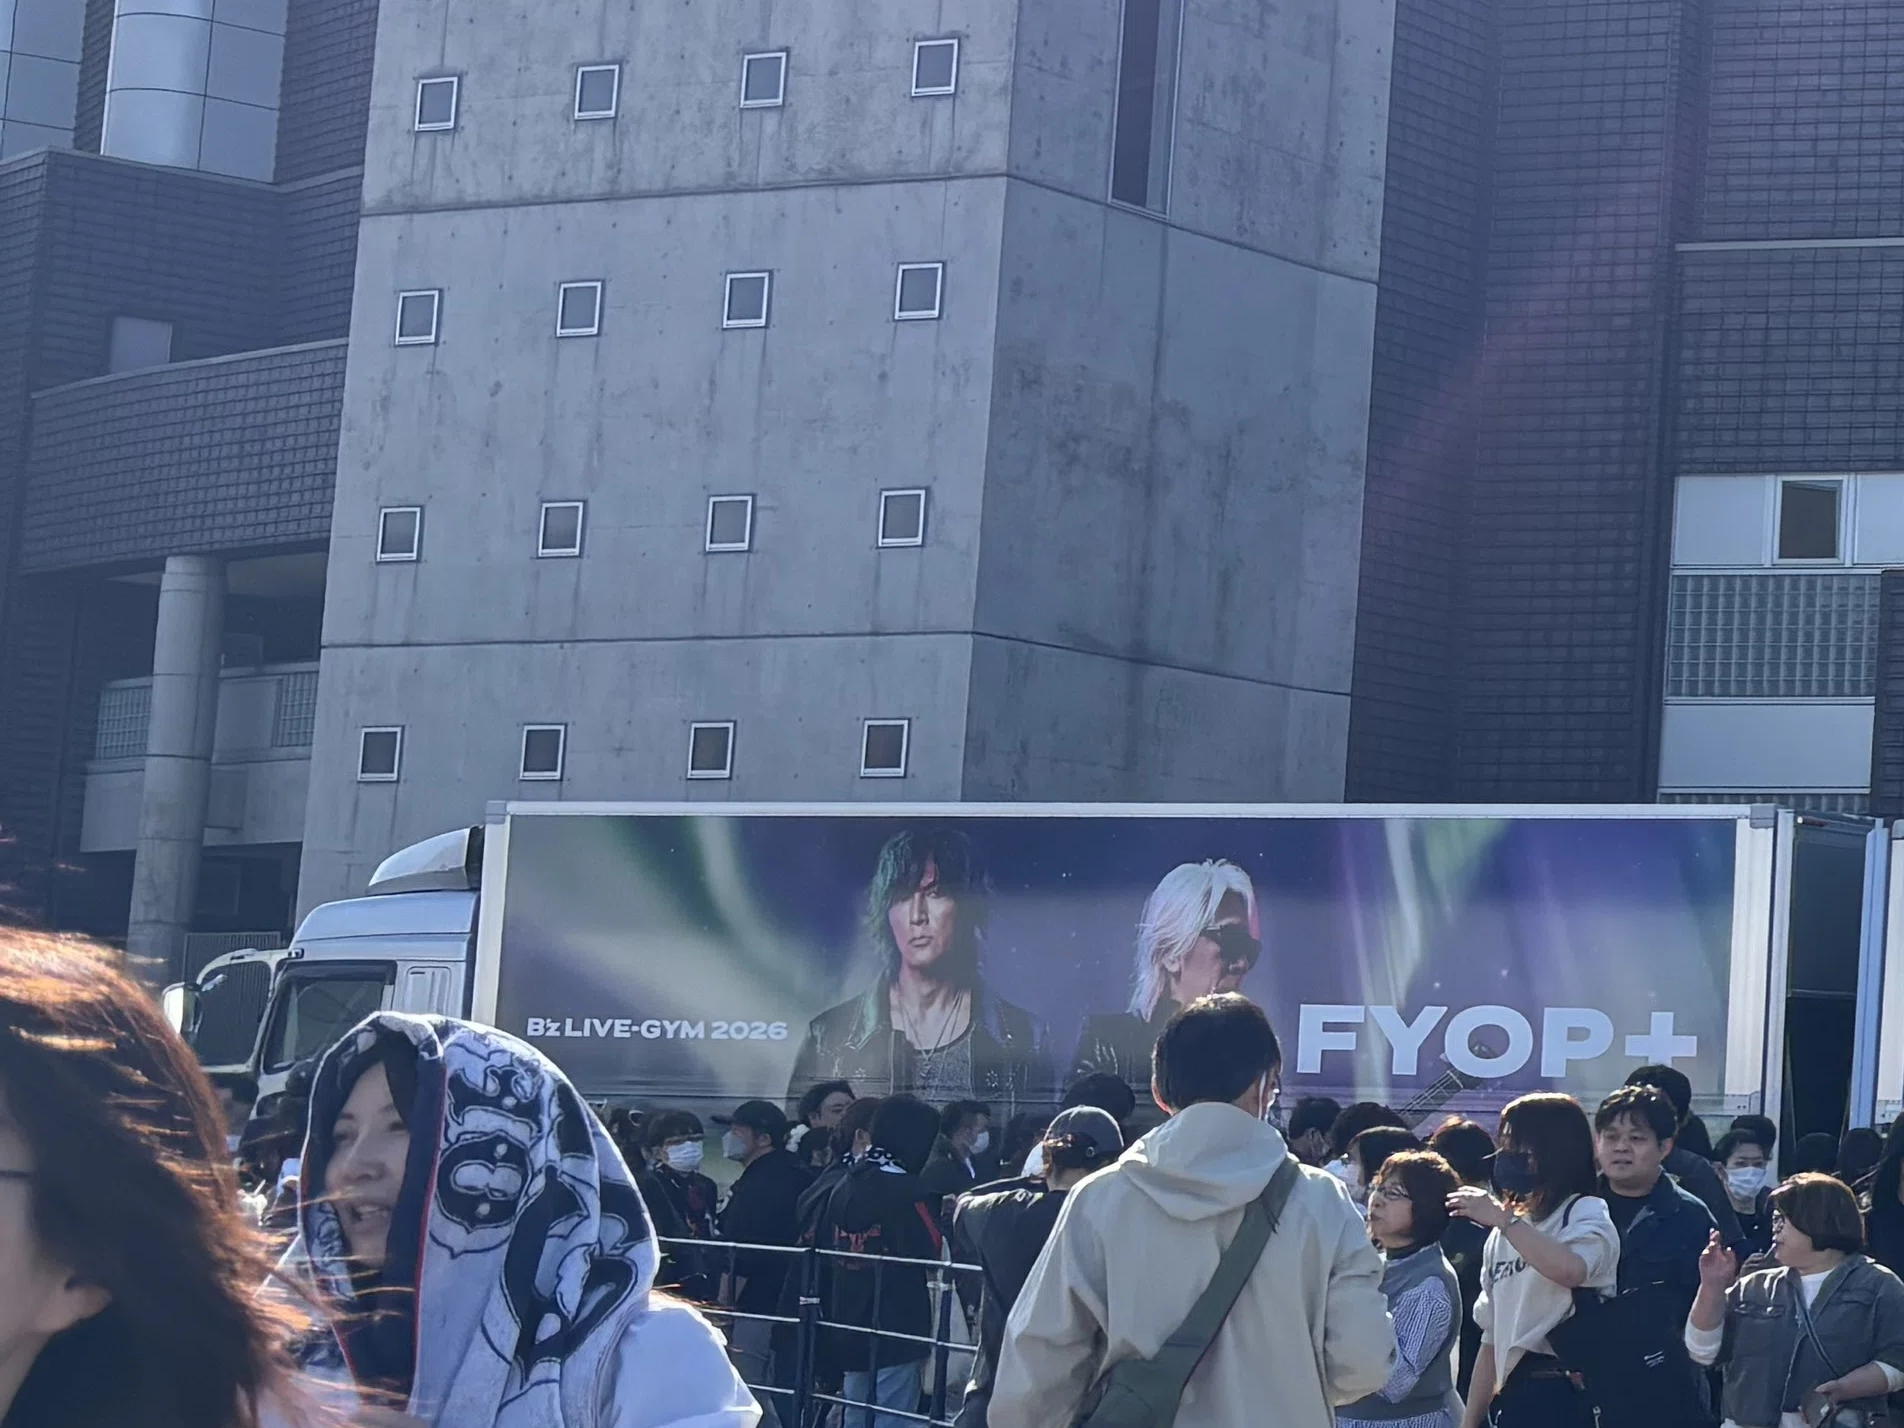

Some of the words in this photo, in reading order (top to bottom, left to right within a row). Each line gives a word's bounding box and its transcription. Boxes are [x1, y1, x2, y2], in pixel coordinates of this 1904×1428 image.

[526, 1017, 560, 1037] B'z
[564, 1018, 705, 1040] LIVE-GYM
[711, 1020, 788, 1040] 2026
